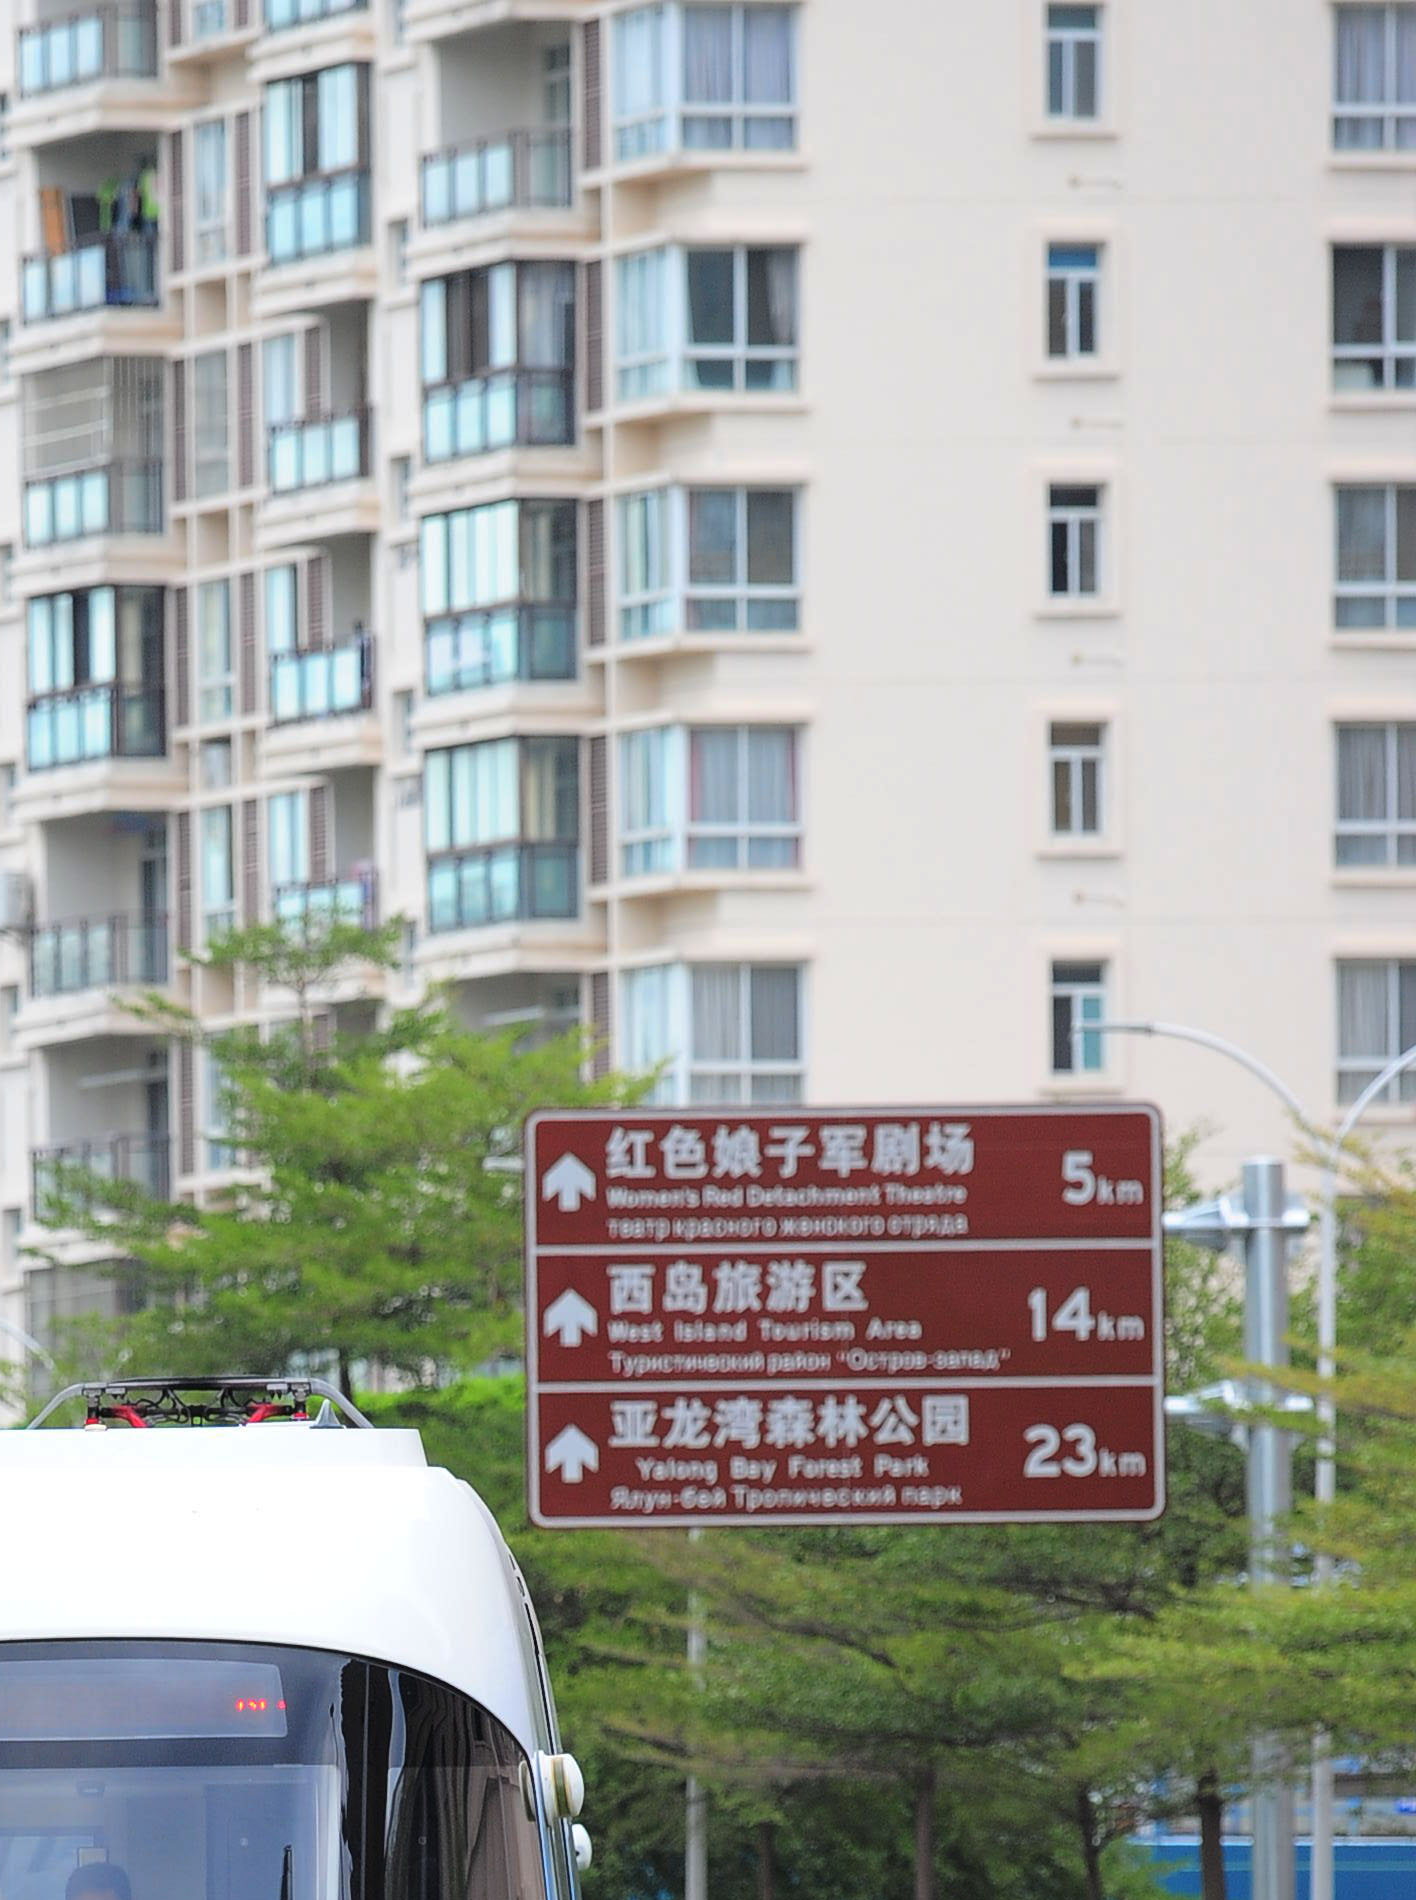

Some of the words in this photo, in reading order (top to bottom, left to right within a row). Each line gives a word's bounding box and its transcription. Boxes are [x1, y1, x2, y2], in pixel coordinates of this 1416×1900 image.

[606, 1122, 974, 1179] 红色娘子军剧场
[606, 1185, 699, 1208] Women's
[702, 1184, 743, 1208] Red
[746, 1183, 881, 1206] Detachment
[883, 1181, 968, 1204] Theatre
[607, 1260, 868, 1314] 西岛旅游区
[1028, 1286, 1145, 1341] 14km
[607, 1319, 664, 1342] West
[674, 1319, 747, 1342] Island
[757, 1318, 855, 1341] Tourism
[865, 1317, 922, 1340] Area
[608, 1395, 969, 1449] 亚龙湾森林公园
[636, 1456, 718, 1484] Yalong
[730, 1456, 777, 1483] Bay
[788, 1455, 863, 1478] Forest
[874, 1453, 929, 1477] Park
[1023, 1423, 1147, 1478] 23km
